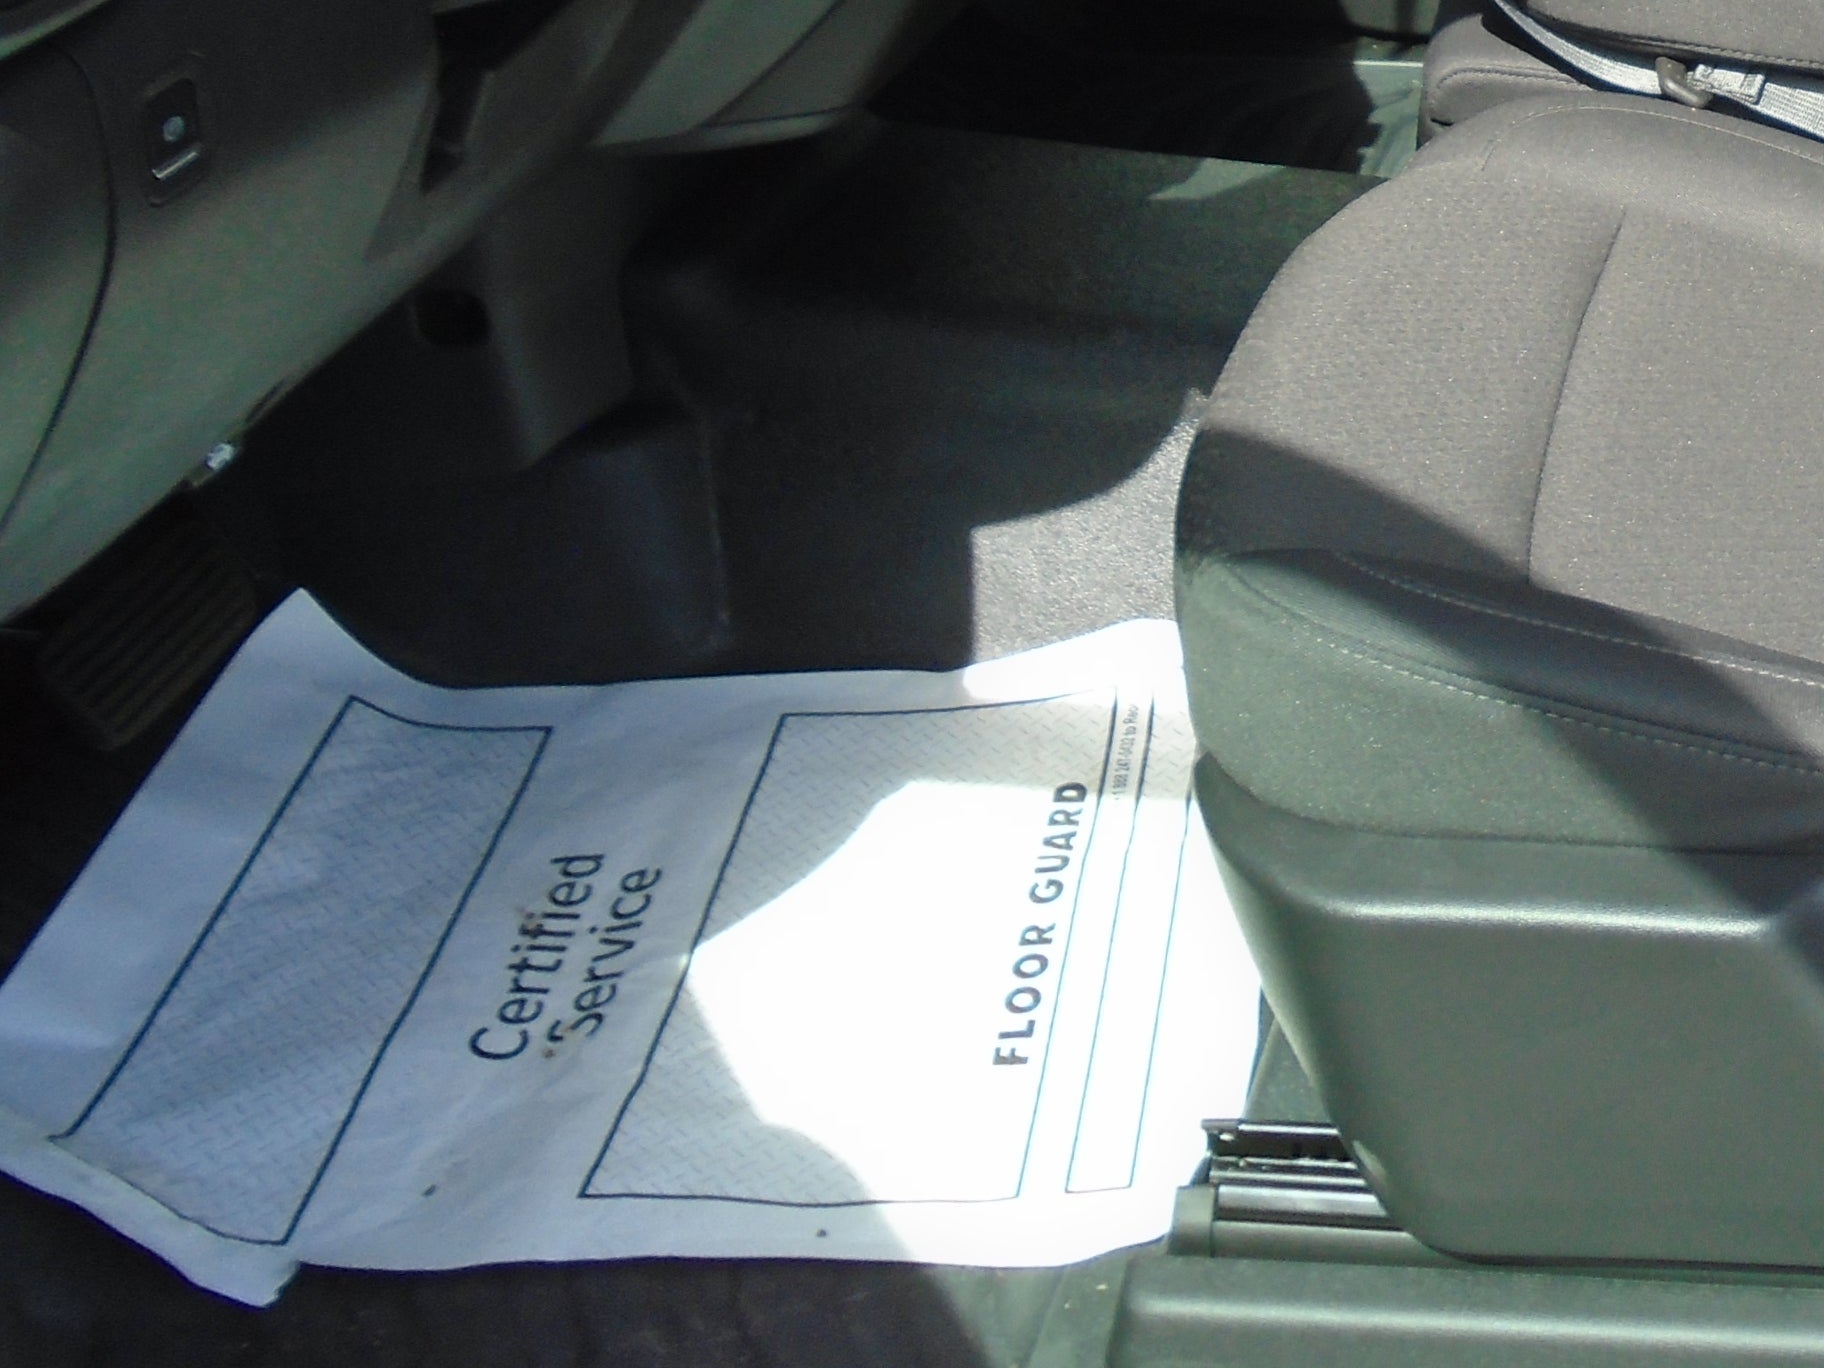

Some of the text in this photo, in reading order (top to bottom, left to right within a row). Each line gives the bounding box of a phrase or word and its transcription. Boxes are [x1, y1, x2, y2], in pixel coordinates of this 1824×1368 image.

[469, 854, 605, 1060] Certified
[546, 868, 662, 1037] Service
[992, 782, 1088, 1065] FLOOR GUARD
